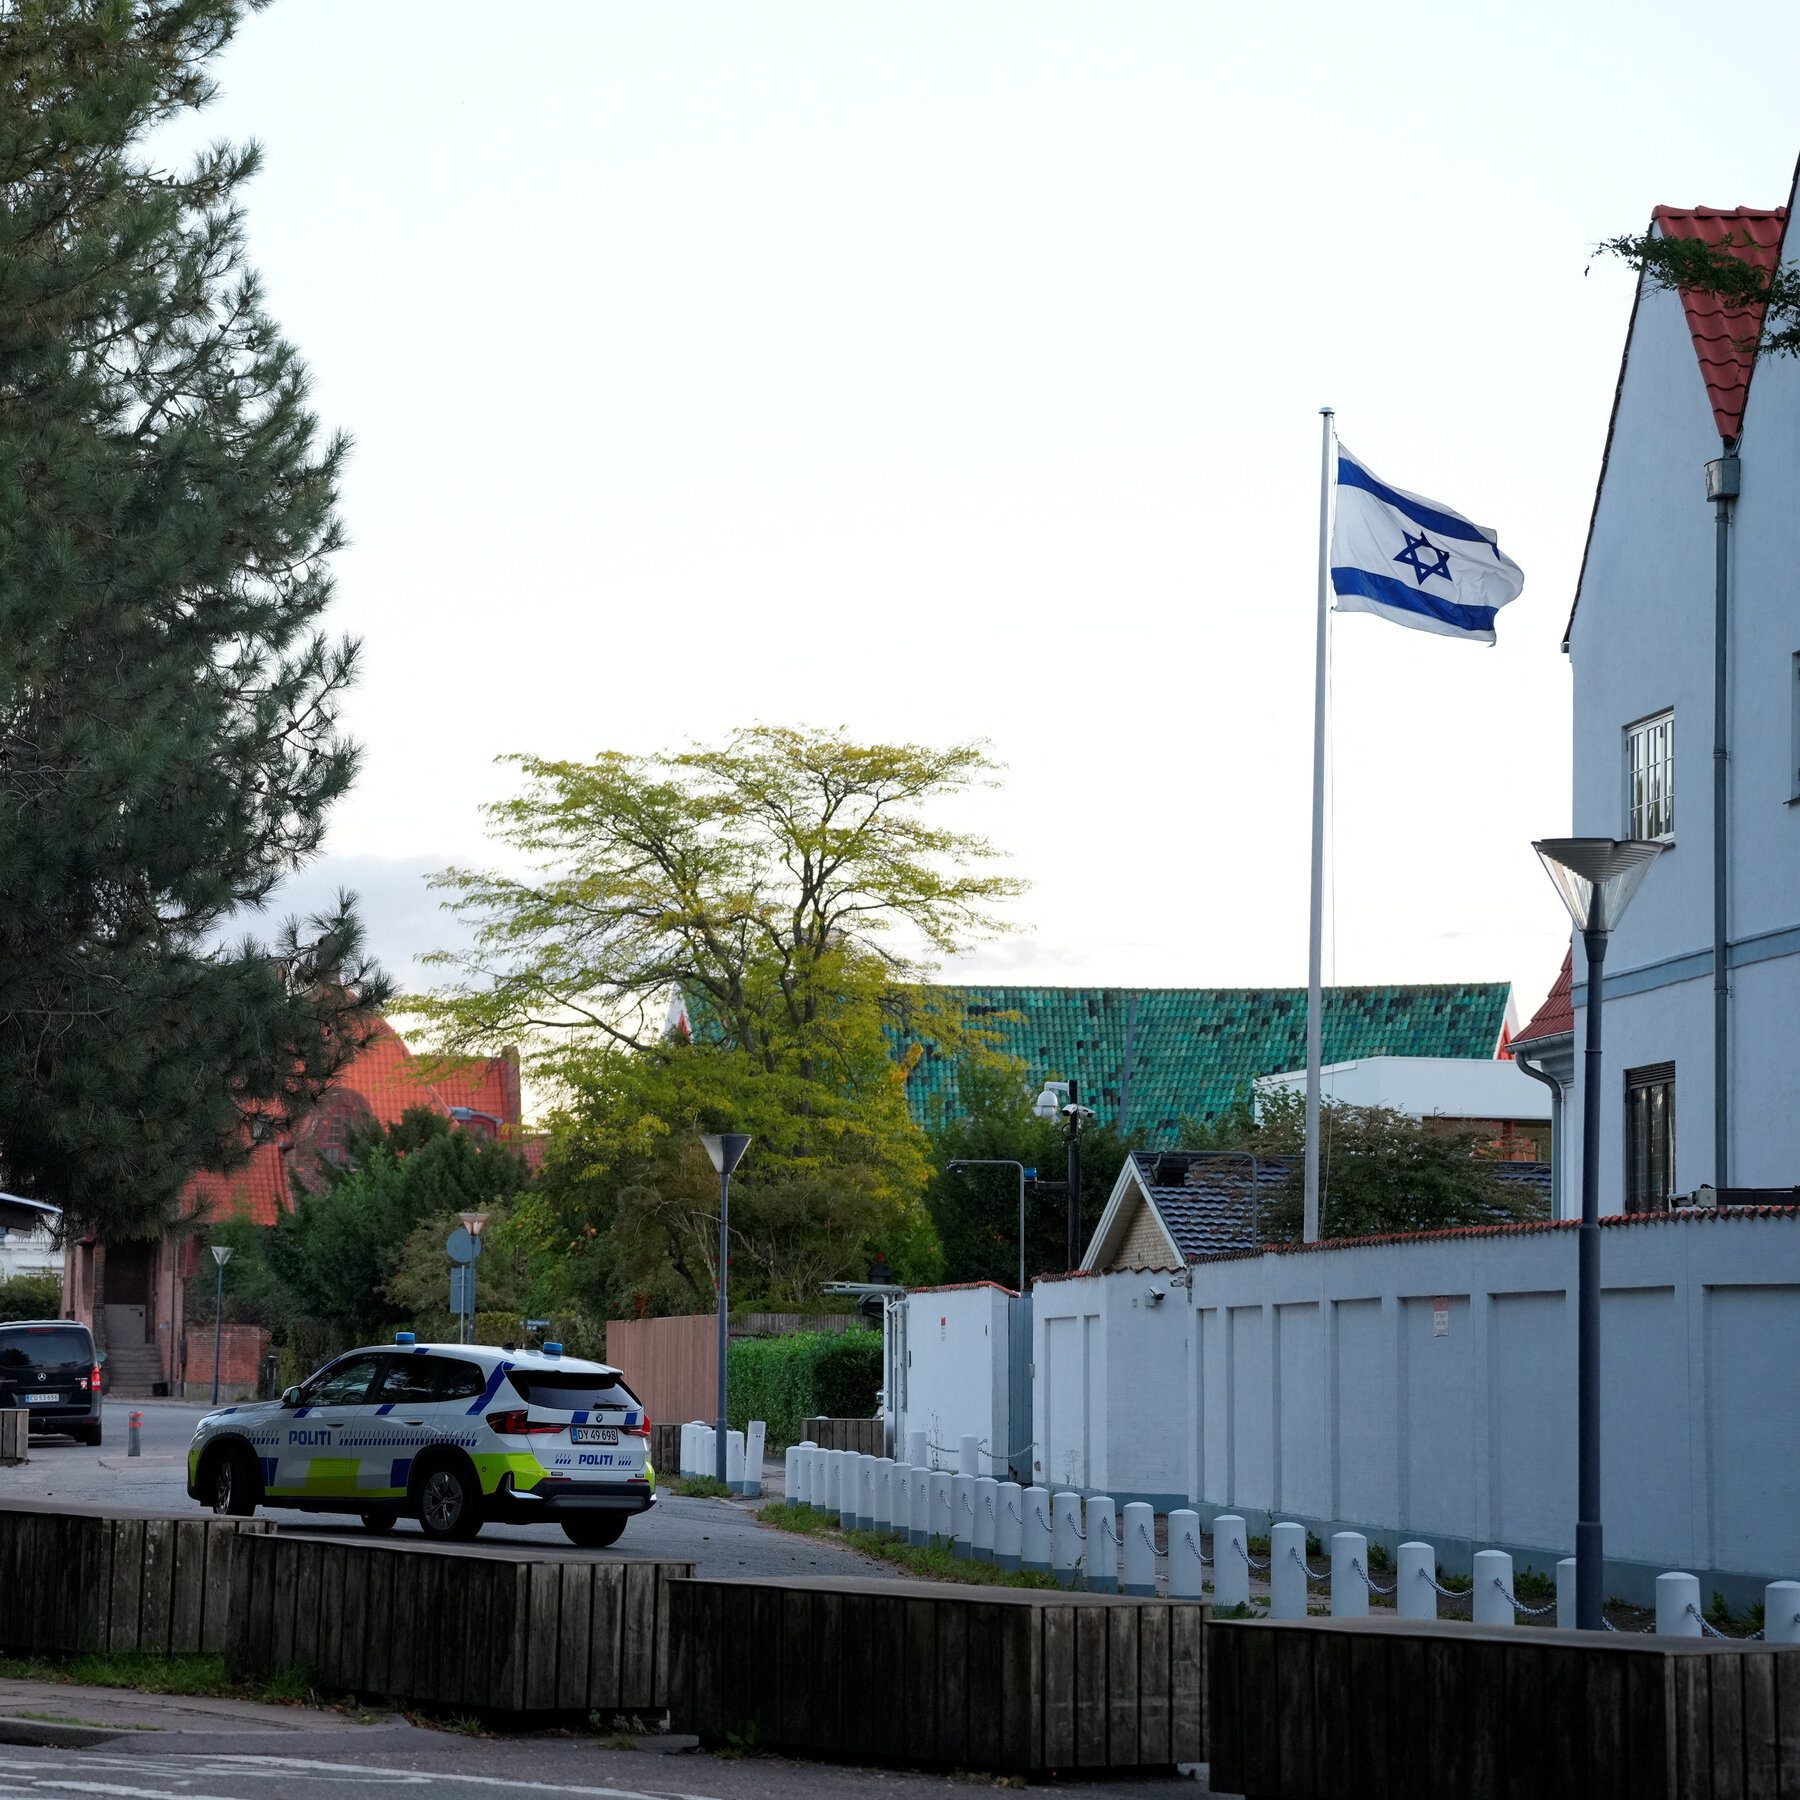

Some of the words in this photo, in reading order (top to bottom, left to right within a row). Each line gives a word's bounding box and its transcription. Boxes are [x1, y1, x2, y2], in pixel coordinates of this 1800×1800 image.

[288, 1430, 332, 1446] POLITI
[577, 1429, 589, 1440] DY
[590, 1430, 600, 1440] 49
[602, 1430, 617, 1441] 698
[578, 1454, 614, 1466] POLITI
